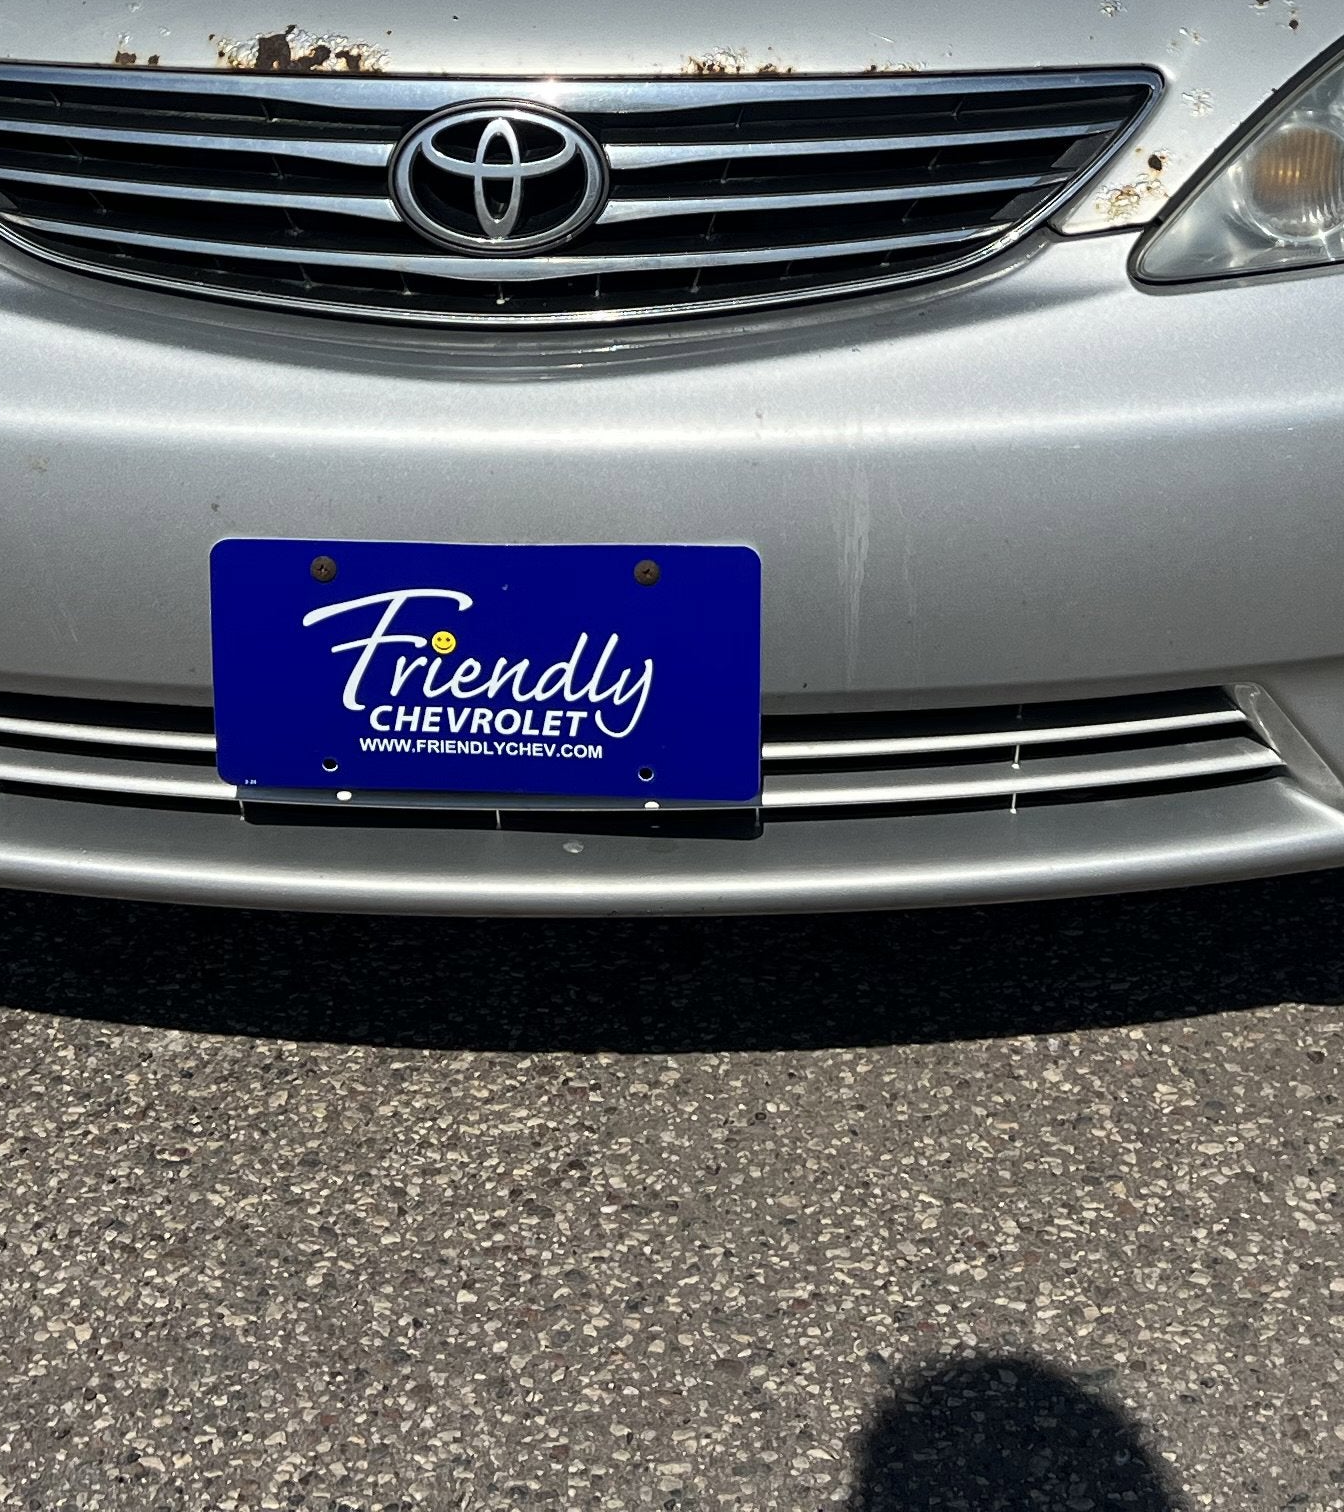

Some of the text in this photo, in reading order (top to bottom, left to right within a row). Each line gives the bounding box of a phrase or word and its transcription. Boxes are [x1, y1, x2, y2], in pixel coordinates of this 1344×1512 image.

[302, 588, 653, 738] Friendly
[369, 705, 588, 737] CHEVROLET
[359, 737, 603, 759] WWW.FRIENDLYCHEV.COM
